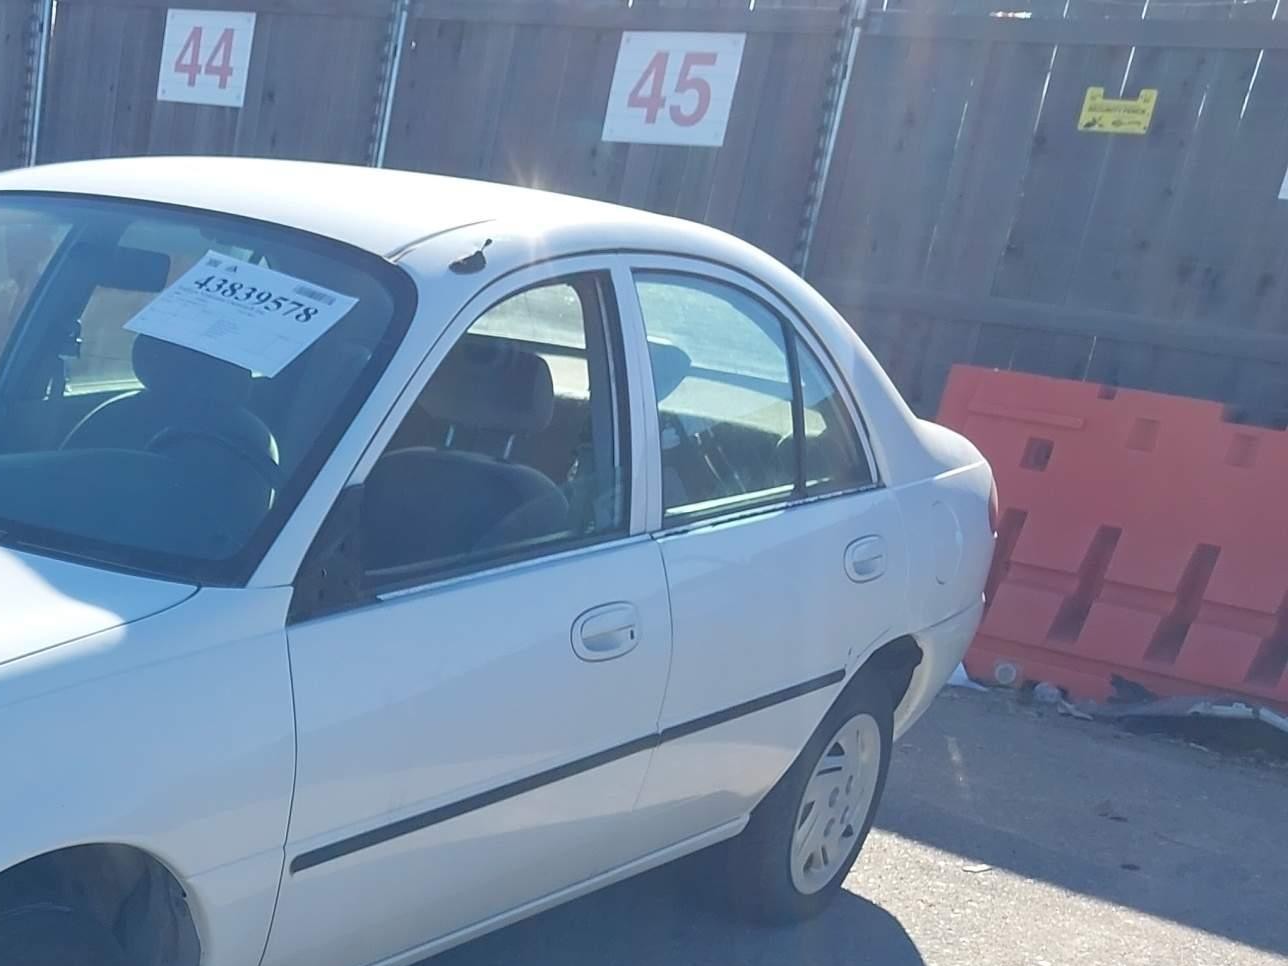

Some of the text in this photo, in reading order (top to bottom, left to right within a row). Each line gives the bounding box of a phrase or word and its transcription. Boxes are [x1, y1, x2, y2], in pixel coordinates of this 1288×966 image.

[174, 26, 234, 90] 44
[627, 50, 718, 127] 45
[194, 275, 319, 322] 43839578
